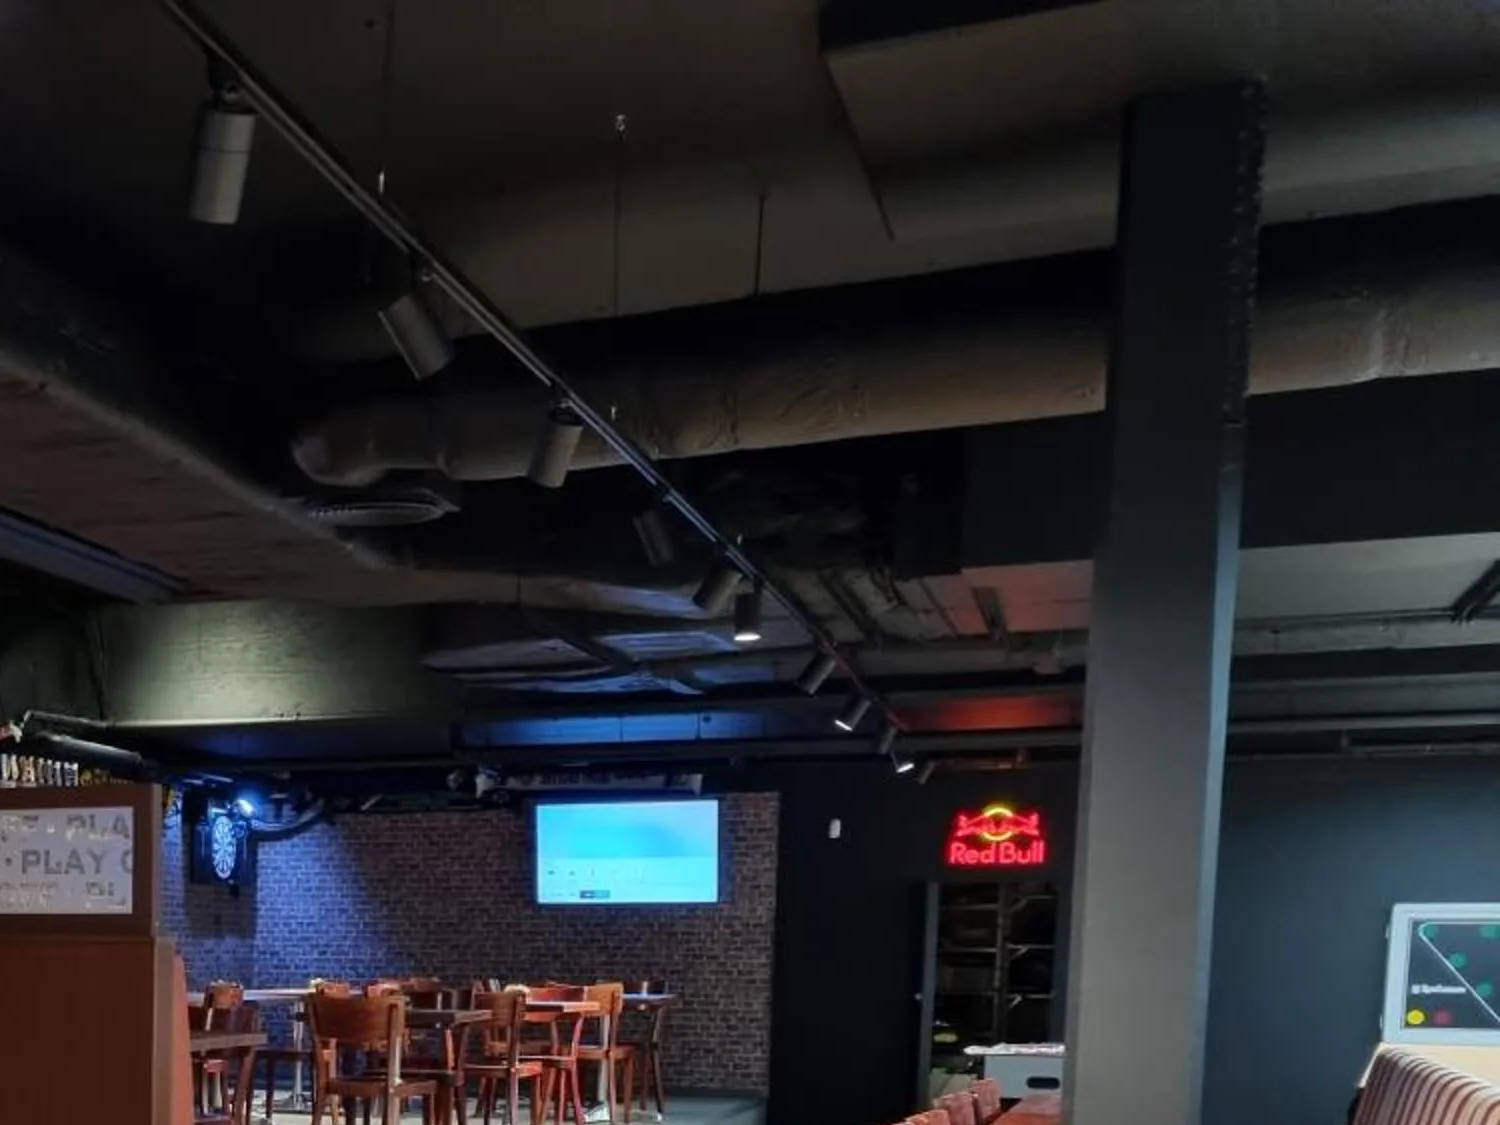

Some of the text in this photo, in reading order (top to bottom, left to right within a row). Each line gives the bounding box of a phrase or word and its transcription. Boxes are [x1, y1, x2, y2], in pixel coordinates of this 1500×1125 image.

[21, 847, 107, 875] PLAY
[950, 840, 1045, 864] Red Bull
